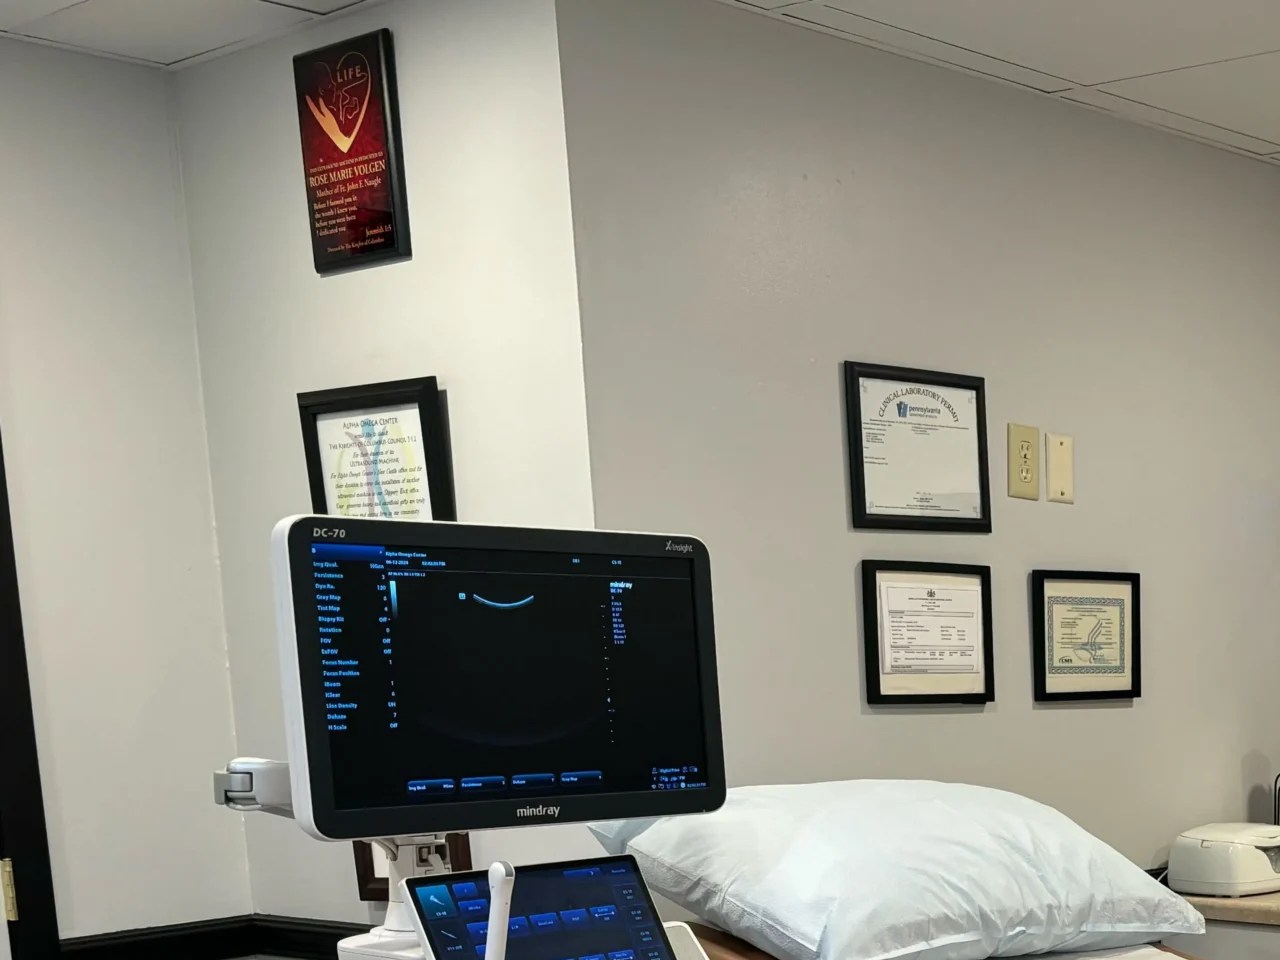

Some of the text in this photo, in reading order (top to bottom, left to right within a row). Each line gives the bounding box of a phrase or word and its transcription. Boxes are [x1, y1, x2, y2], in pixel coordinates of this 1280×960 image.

[337, 65, 361, 83] LIFE
[310, 160, 386, 187] ROSE MARIE VOLGEN
[316, 187, 333, 198] Mother
[334, 186, 340, 194] of
[347, 181, 358, 193] John
[879, 387, 959, 423] CLINICAL LABORATORY PERMIT
[909, 405, 941, 415] pennsylvania
[360, 419, 378, 427] OMEGA
[380, 418, 398, 426] CENTER
[313, 527, 346, 538] DC-70
[516, 805, 561, 818] mindray
